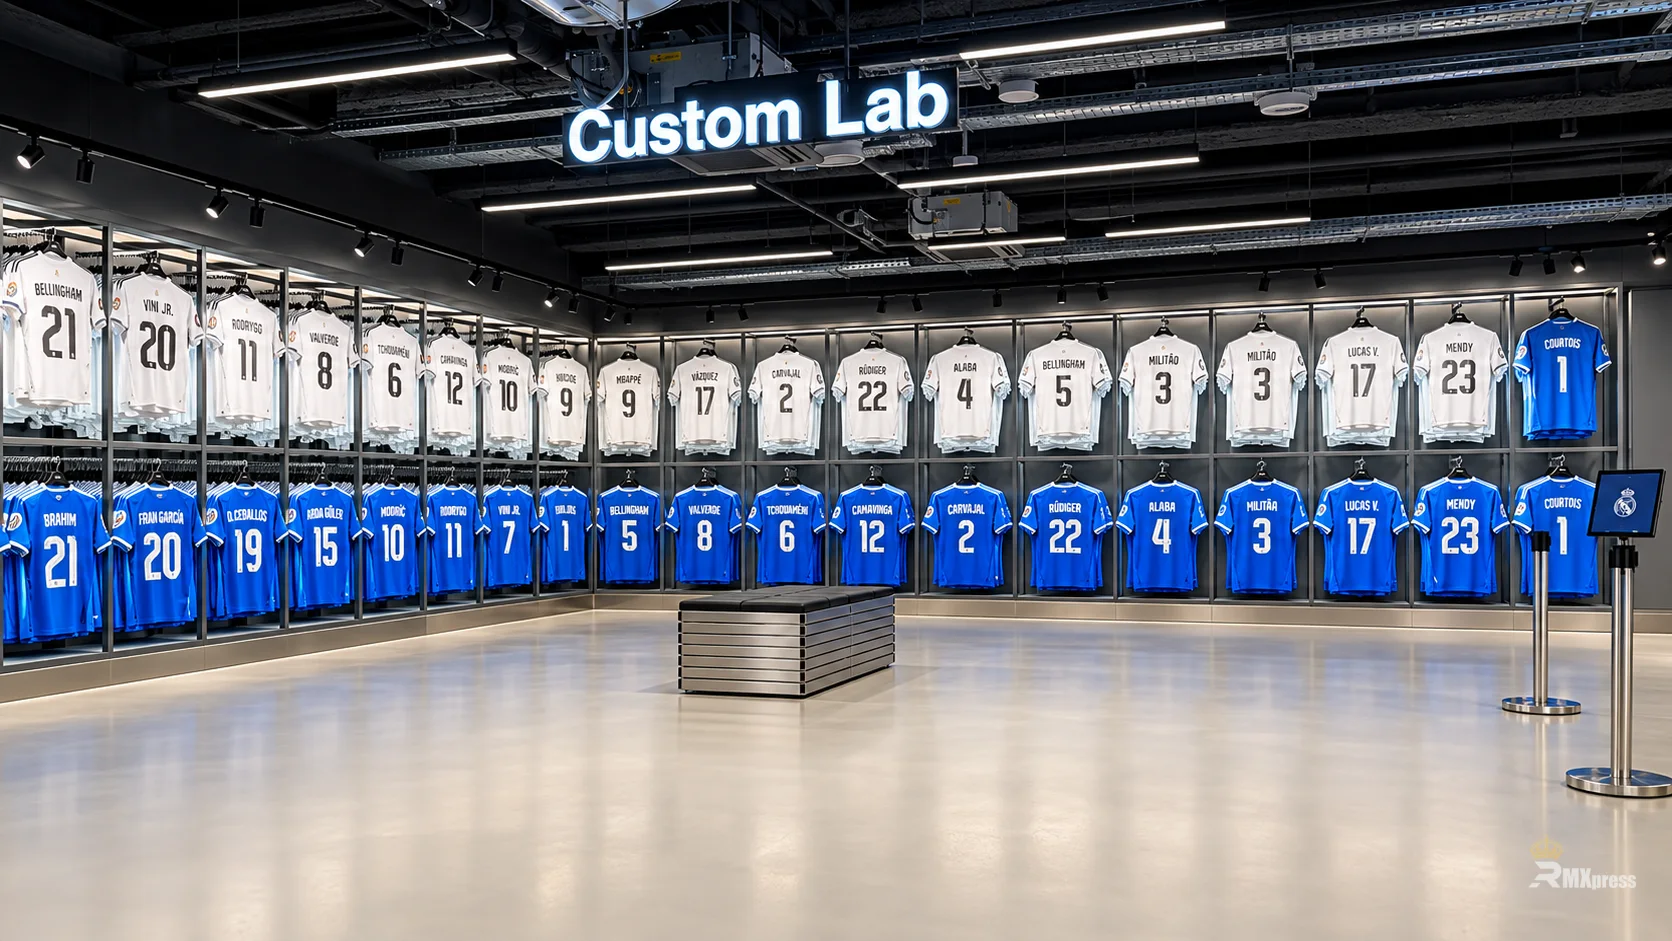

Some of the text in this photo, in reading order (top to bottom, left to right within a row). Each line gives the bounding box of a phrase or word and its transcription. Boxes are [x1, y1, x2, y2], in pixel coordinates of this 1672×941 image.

[568, 70, 949, 162] Custom Lab
[35, 283, 82, 302] BELLINGHAM
[143, 299, 173, 316] VINI JR.
[41, 305, 76, 360] 21
[140, 321, 176, 371] 20
[310, 332, 339, 347] VALVERDE
[1446, 342, 1473, 353] MENDY
[1544, 337, 1581, 349] COURTOIS
[238, 338, 257, 382] 11
[954, 363, 977, 372] ALABA
[1043, 359, 1085, 370] BELLINGHAM
[1149, 353, 1179, 365] MILITÃO
[1248, 349, 1276, 362] MILITÃO
[1348, 347, 1379, 357] LUCAS V.
[318, 351, 332, 390] 8
[388, 362, 402, 398] 6
[617, 374, 642, 384] MBAPPÉ
[692, 371, 718, 382] VÁZQUEZ
[772, 369, 801, 378] CARVAJAL
[1254, 367, 1271, 401] 3
[1351, 363, 1376, 397] 17
[1442, 359, 1476, 395] 23
[1557, 356, 1567, 392] 1
[445, 371, 463, 405] 12
[500, 379, 518, 412] 10
[560, 388, 573, 417] 9
[622, 389, 635, 418] 9
[695, 386, 715, 416] 17
[780, 383, 793, 413] 2
[858, 381, 887, 412] 22
[957, 378, 973, 409] 4
[1056, 375, 1072, 407] 5
[1155, 372, 1172, 405] 3
[139, 509, 184, 525] FRAN GARCÍA
[610, 506, 649, 515] BELLINGHAM
[852, 505, 893, 515] CAMAVINGA
[948, 504, 985, 515] CARVAJAL
[1049, 500, 1081, 513] RÜDIGER
[1149, 502, 1175, 512] ALABA
[1345, 501, 1379, 511] LUCAS V.
[1447, 499, 1476, 510] MENDY
[1544, 497, 1582, 509] COURTOIS
[43, 513, 76, 527] BRAHIM
[562, 520, 569, 551] 1
[622, 519, 638, 551] 5
[697, 520, 713, 552] 8
[780, 520, 795, 552] 6
[958, 519, 974, 553] 2
[1152, 518, 1171, 554] 4
[1253, 518, 1271, 554] 3
[1442, 517, 1479, 555] 23
[1557, 516, 1567, 555] 1
[235, 528, 262, 573] 19
[313, 527, 338, 567] 15
[382, 524, 405, 562] 10
[446, 522, 462, 558] 11
[503, 521, 515, 554] 7
[860, 520, 885, 553] 12
[1049, 519, 1082, 554] 22
[1348, 518, 1376, 555] 17
[44, 535, 78, 588] 21
[143, 532, 181, 581] 20
